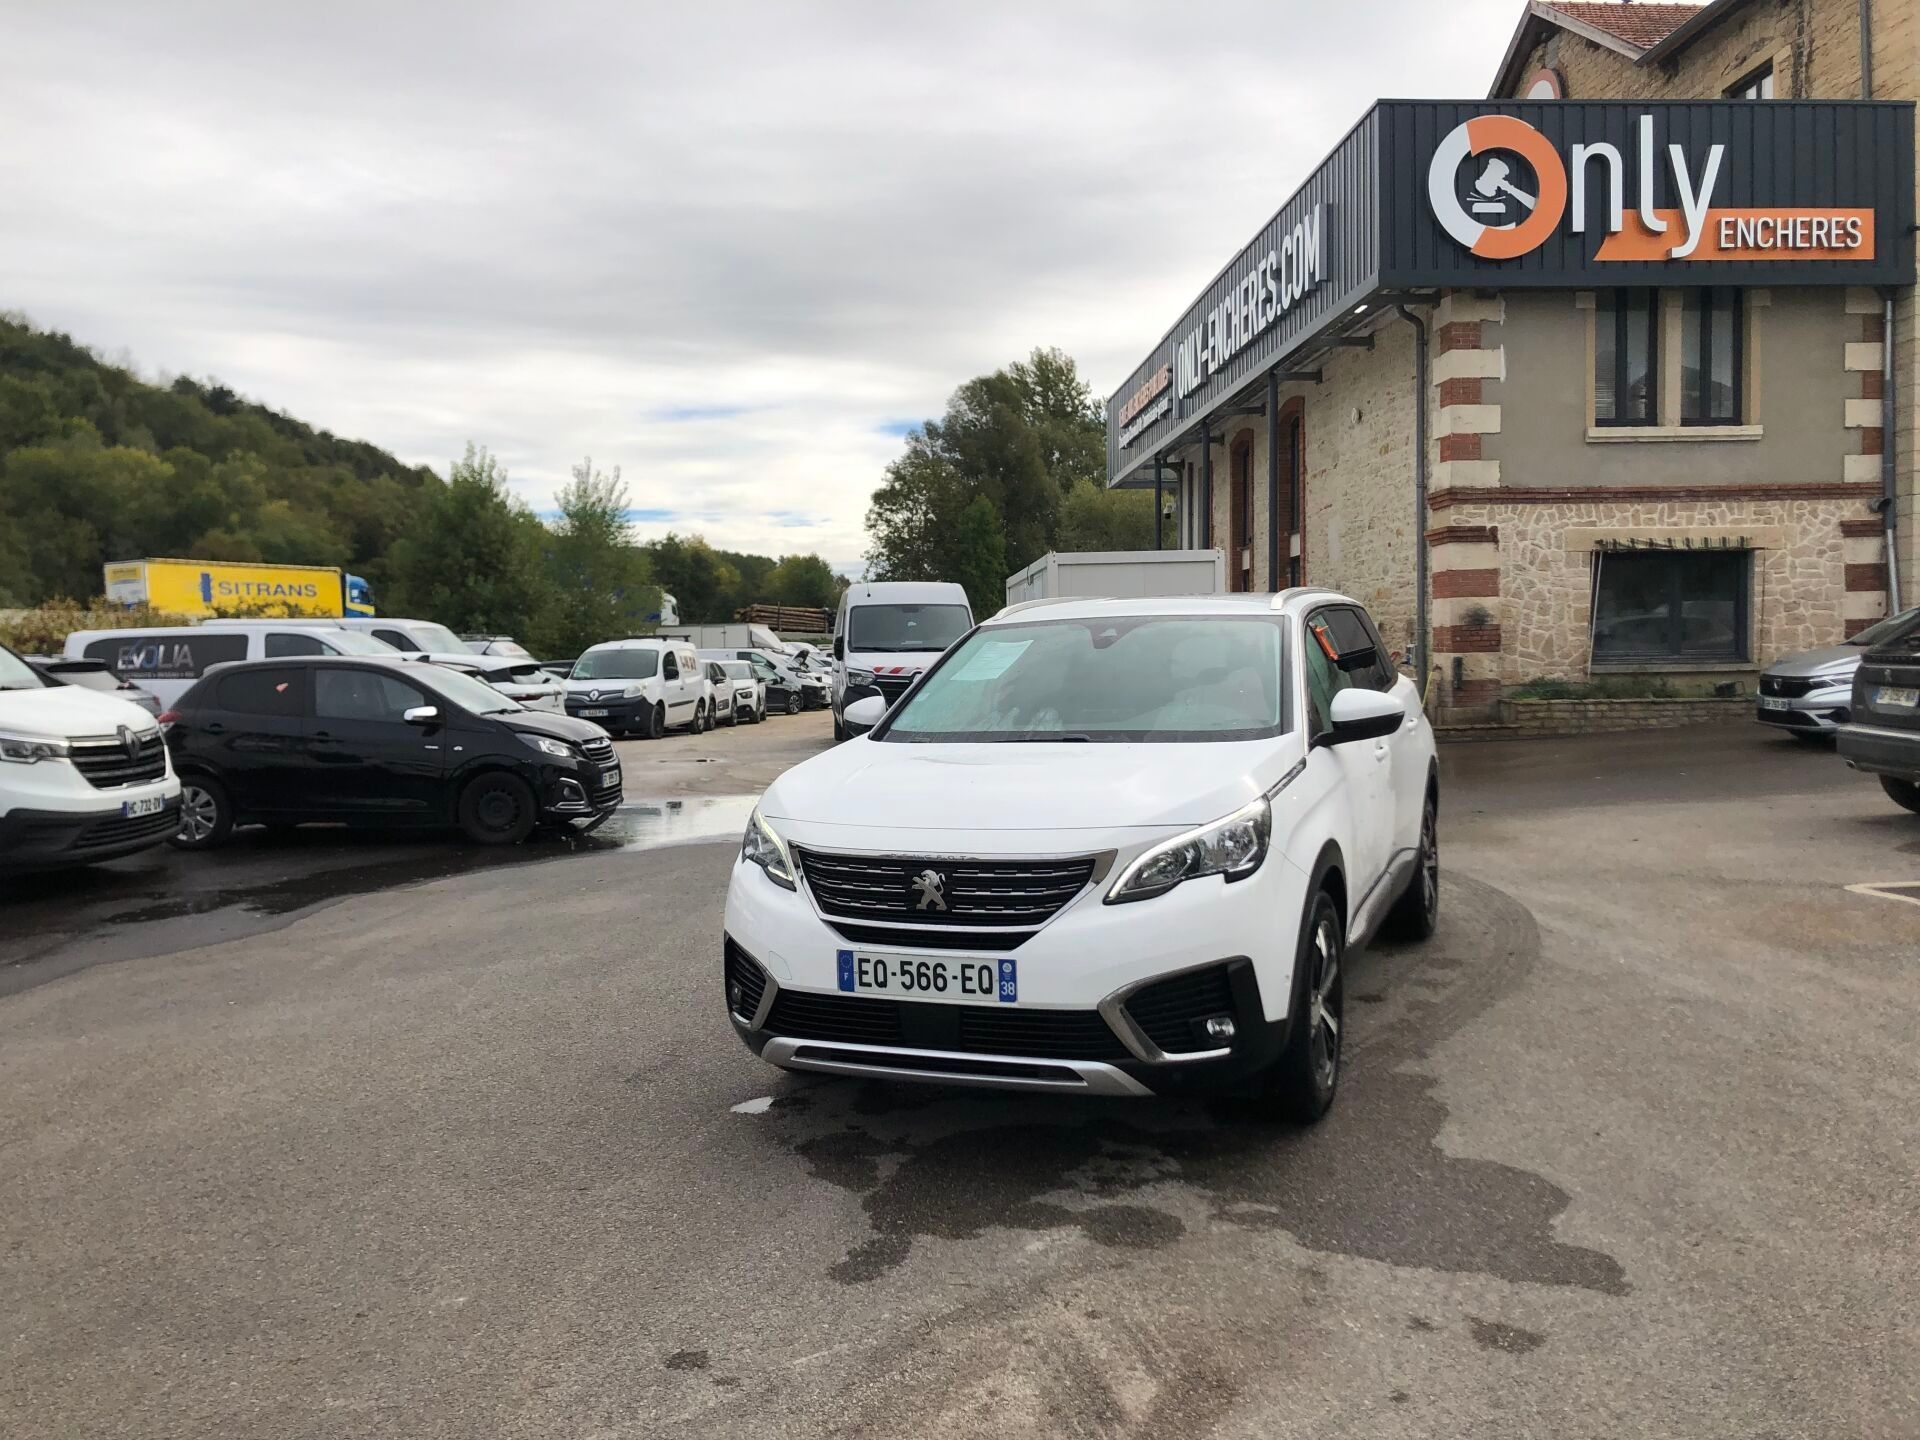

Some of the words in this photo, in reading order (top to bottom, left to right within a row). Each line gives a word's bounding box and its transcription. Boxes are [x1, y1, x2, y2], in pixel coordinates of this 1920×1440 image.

[1720, 216, 1863, 249] ENCHERES
[1178, 203, 1320, 399] ONLY-ENCHERES.COM
[218, 581, 317, 597] SITRANS
[117, 643, 194, 670] EVOLIA
[857, 957, 994, 995] EQ-566-EQ
[1000, 981, 1016, 996] 38
